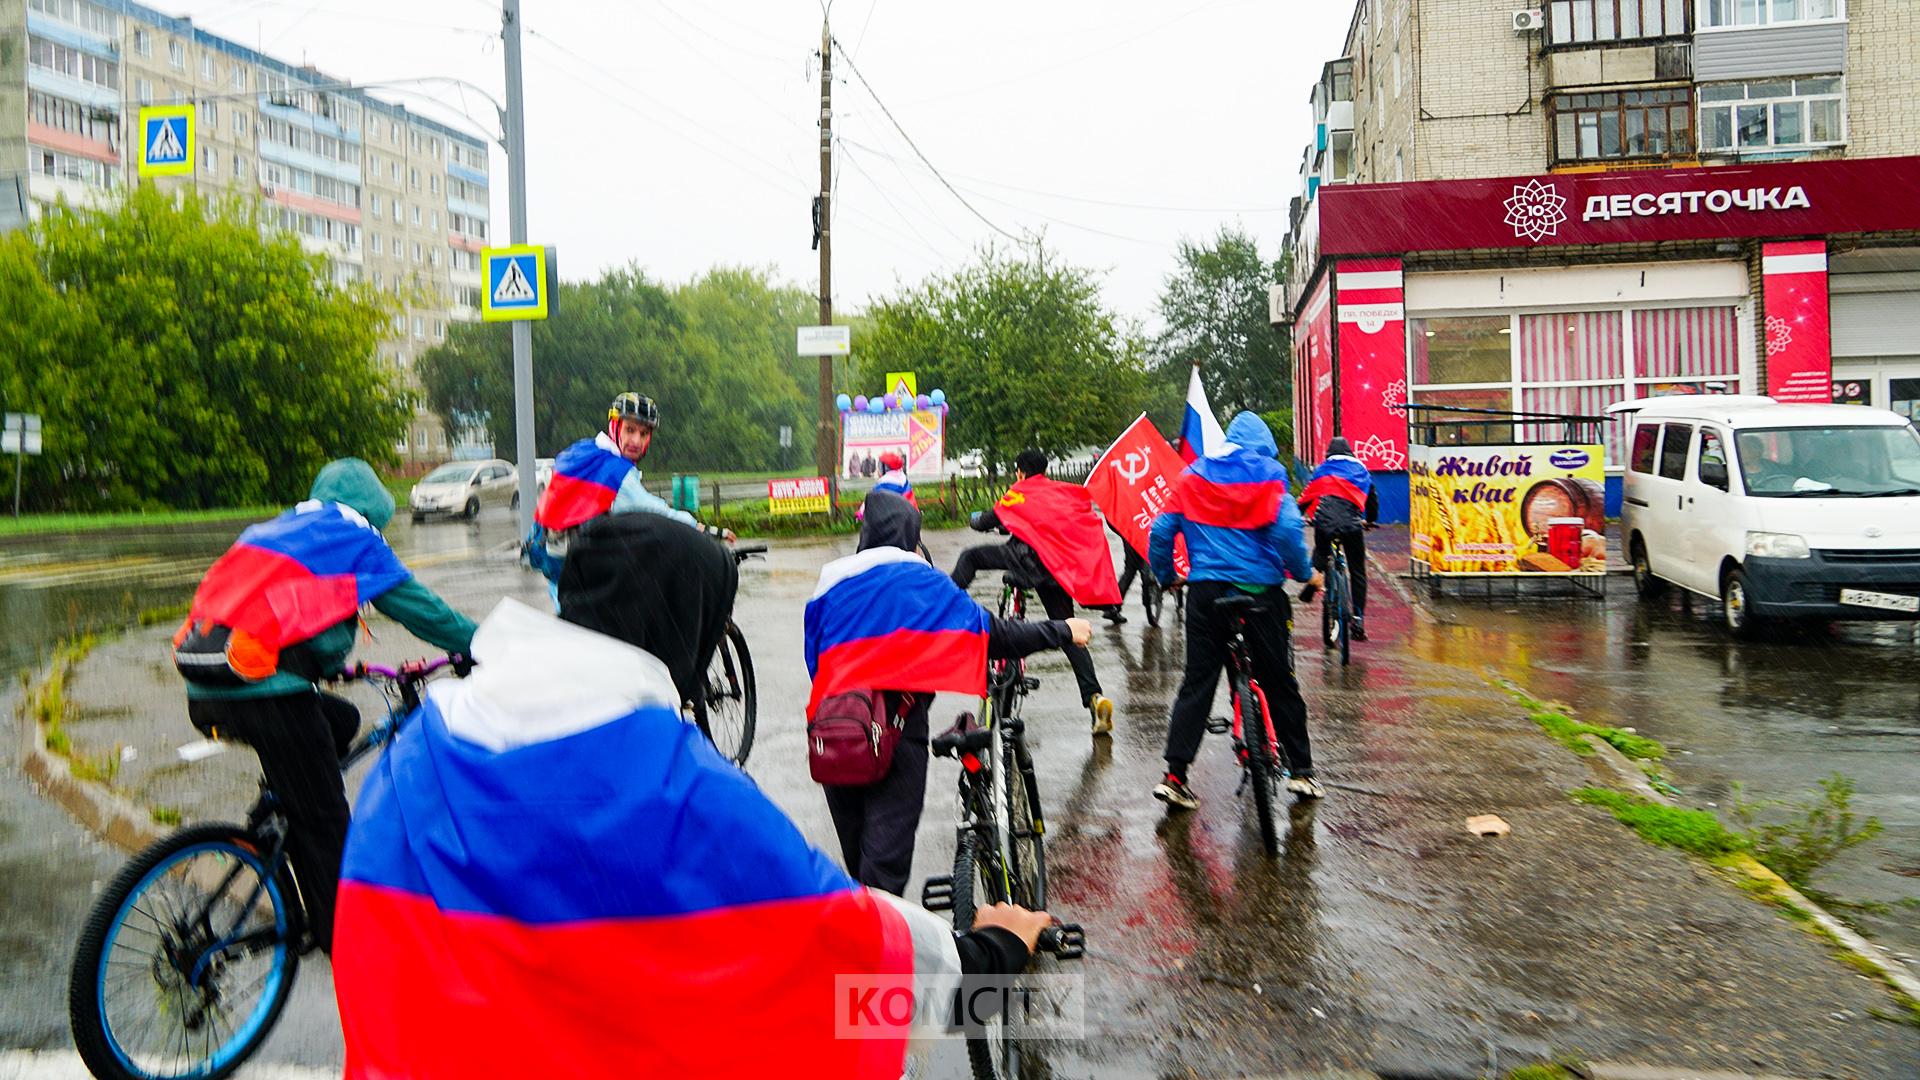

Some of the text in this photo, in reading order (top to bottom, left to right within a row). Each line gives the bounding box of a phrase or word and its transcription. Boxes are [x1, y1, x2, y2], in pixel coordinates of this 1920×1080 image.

[1526, 205, 1545, 217] 10
[1582, 186, 1811, 222] ДЕСЯТОЧКА
[1436, 455, 1532, 476] Живой
[1453, 482, 1517, 504] квас
